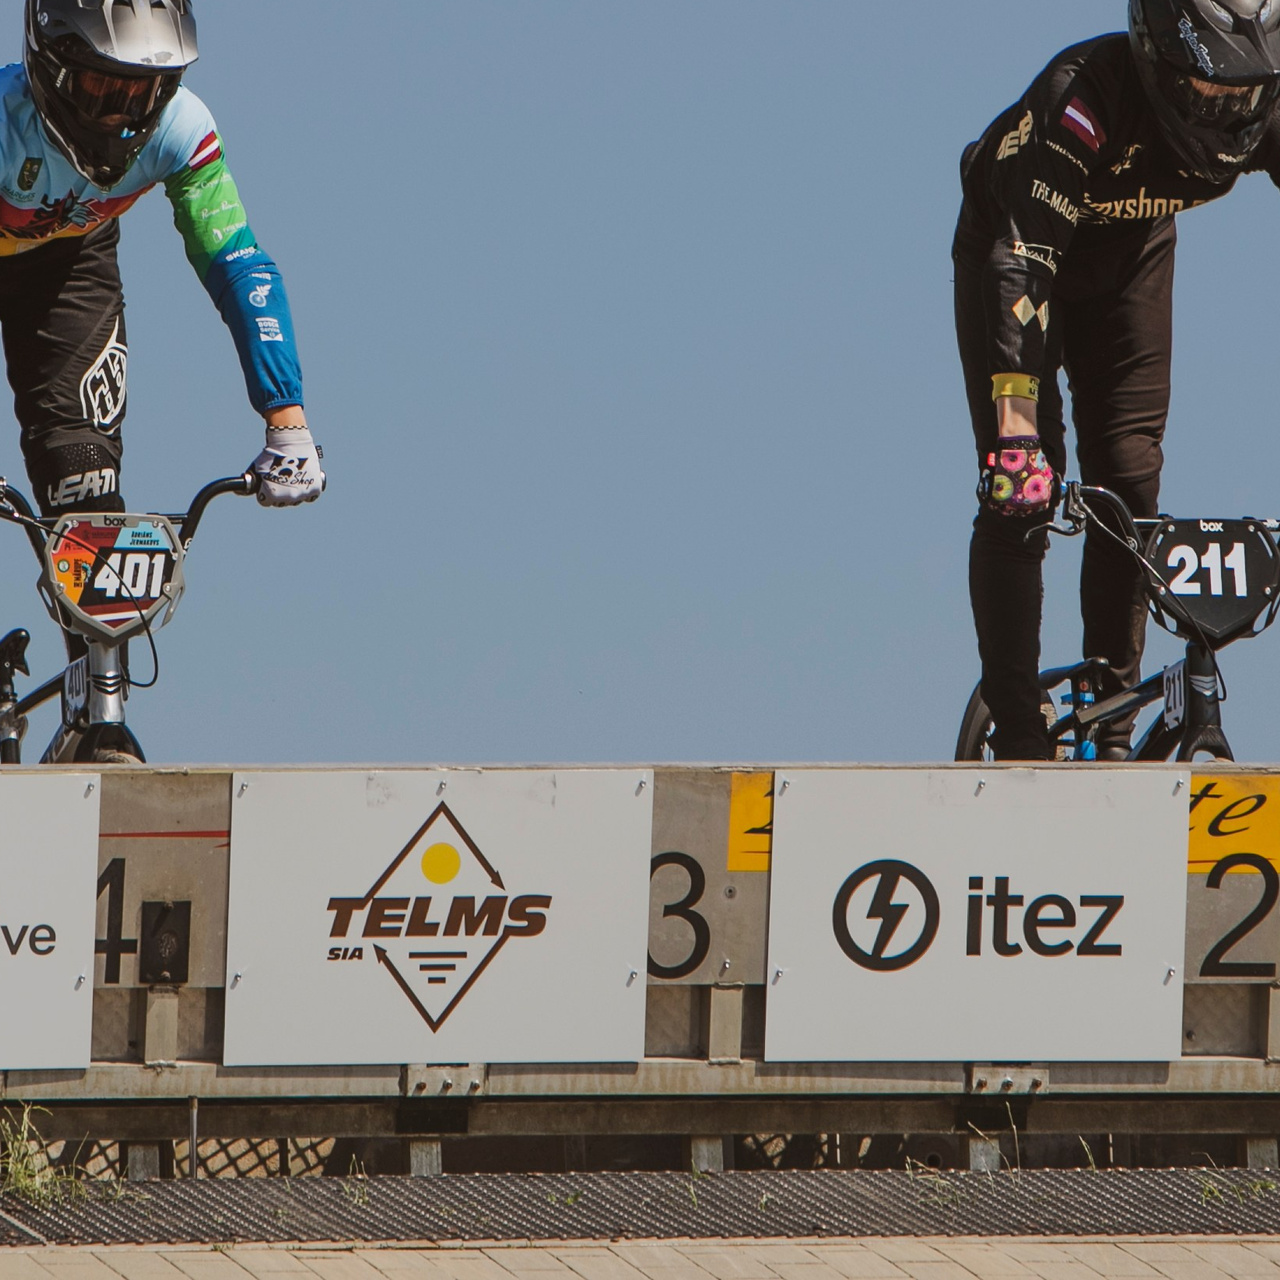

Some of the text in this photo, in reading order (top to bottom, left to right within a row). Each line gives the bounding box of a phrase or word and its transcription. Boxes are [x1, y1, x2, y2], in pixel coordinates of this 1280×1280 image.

[290, 471, 314, 489] Shop
[104, 515, 127, 526] box
[1199, 519, 1224, 532] box
[94, 552, 166, 599] 401
[1167, 542, 1248, 597] 211
[1165, 669, 1182, 715] 211
[326, 894, 552, 938] TELMS
[647, 851, 711, 979] 3
[966, 874, 1124, 957] itez
[1199, 852, 1280, 978] 2
[326, 946, 364, 961] SIA
